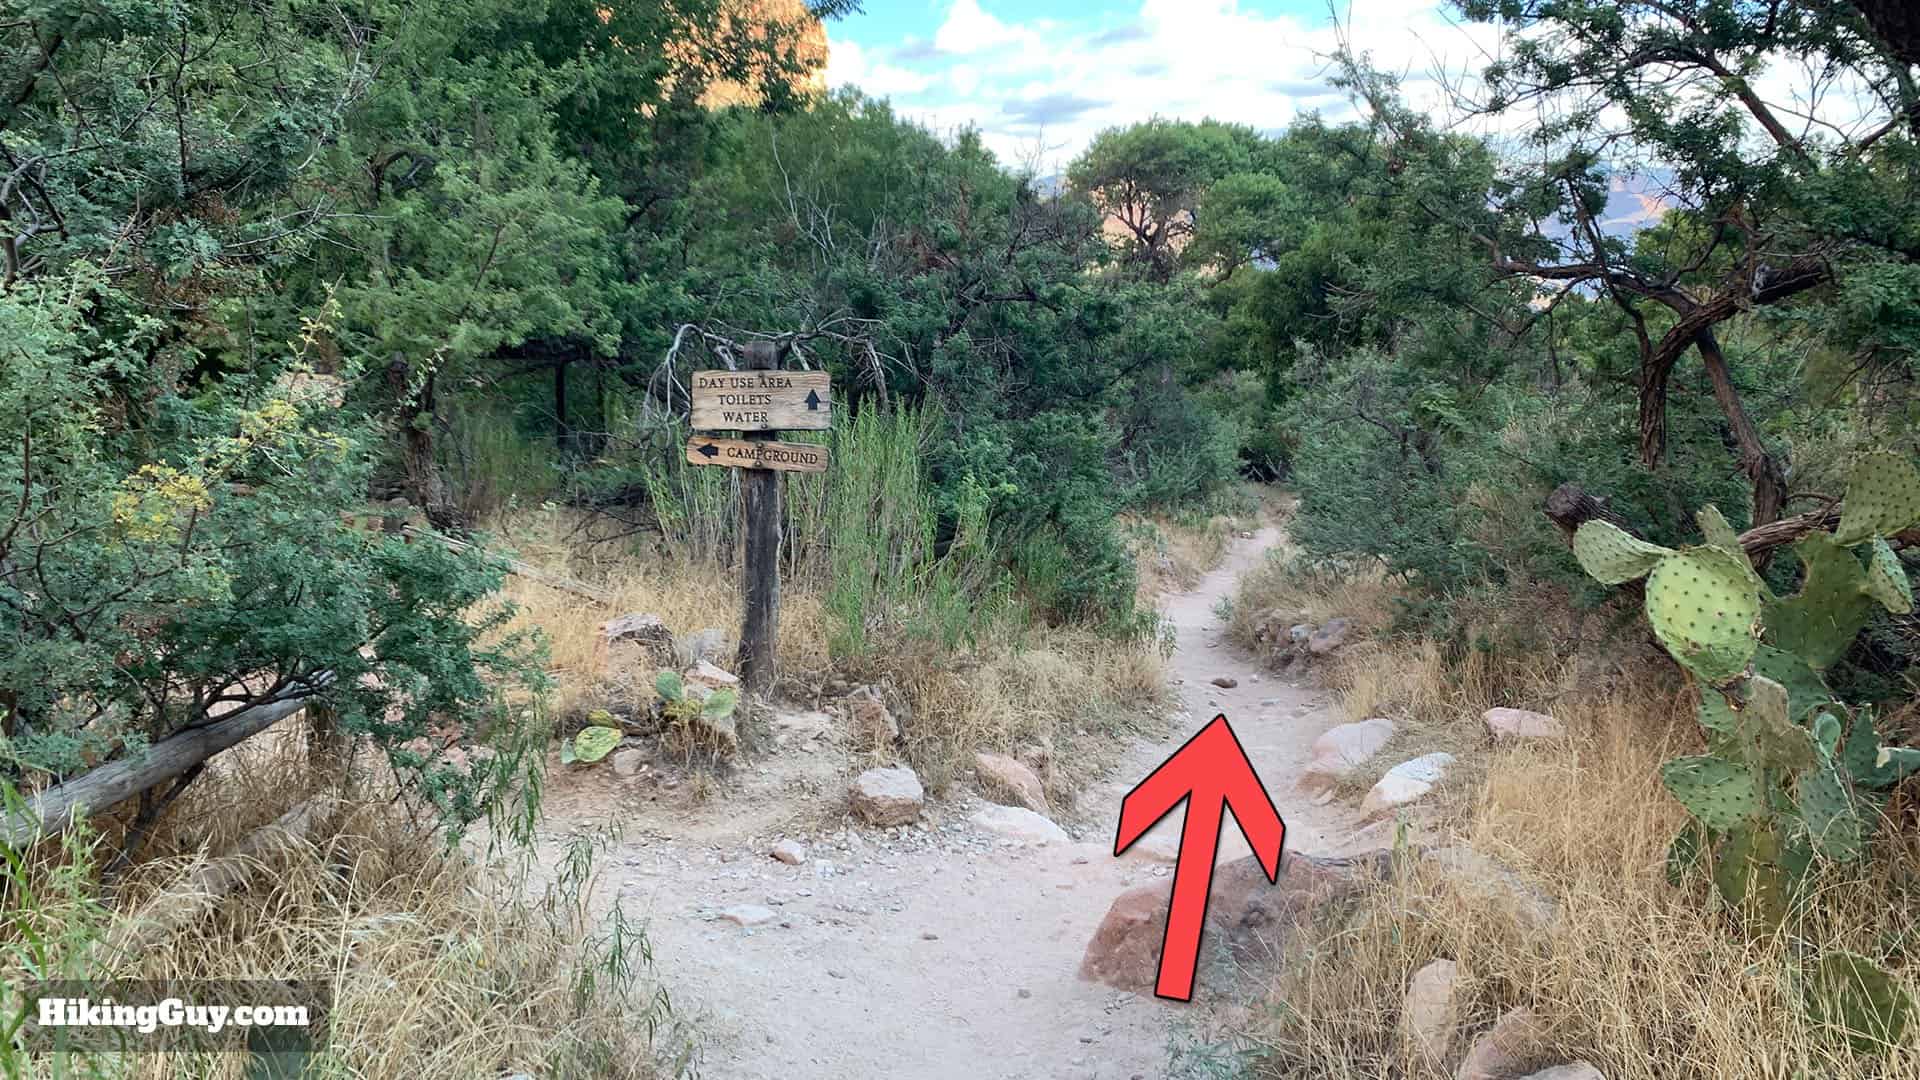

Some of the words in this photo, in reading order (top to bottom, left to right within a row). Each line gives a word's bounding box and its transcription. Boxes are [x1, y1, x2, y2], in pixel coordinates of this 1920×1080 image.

[699, 377, 725, 388] DAY
[730, 377, 753, 388] USE
[760, 377, 793, 388] AREA
[717, 394, 771, 405] TOILETS
[722, 411, 768, 423] WATER
[727, 447, 818, 464] CAMPGROUND
